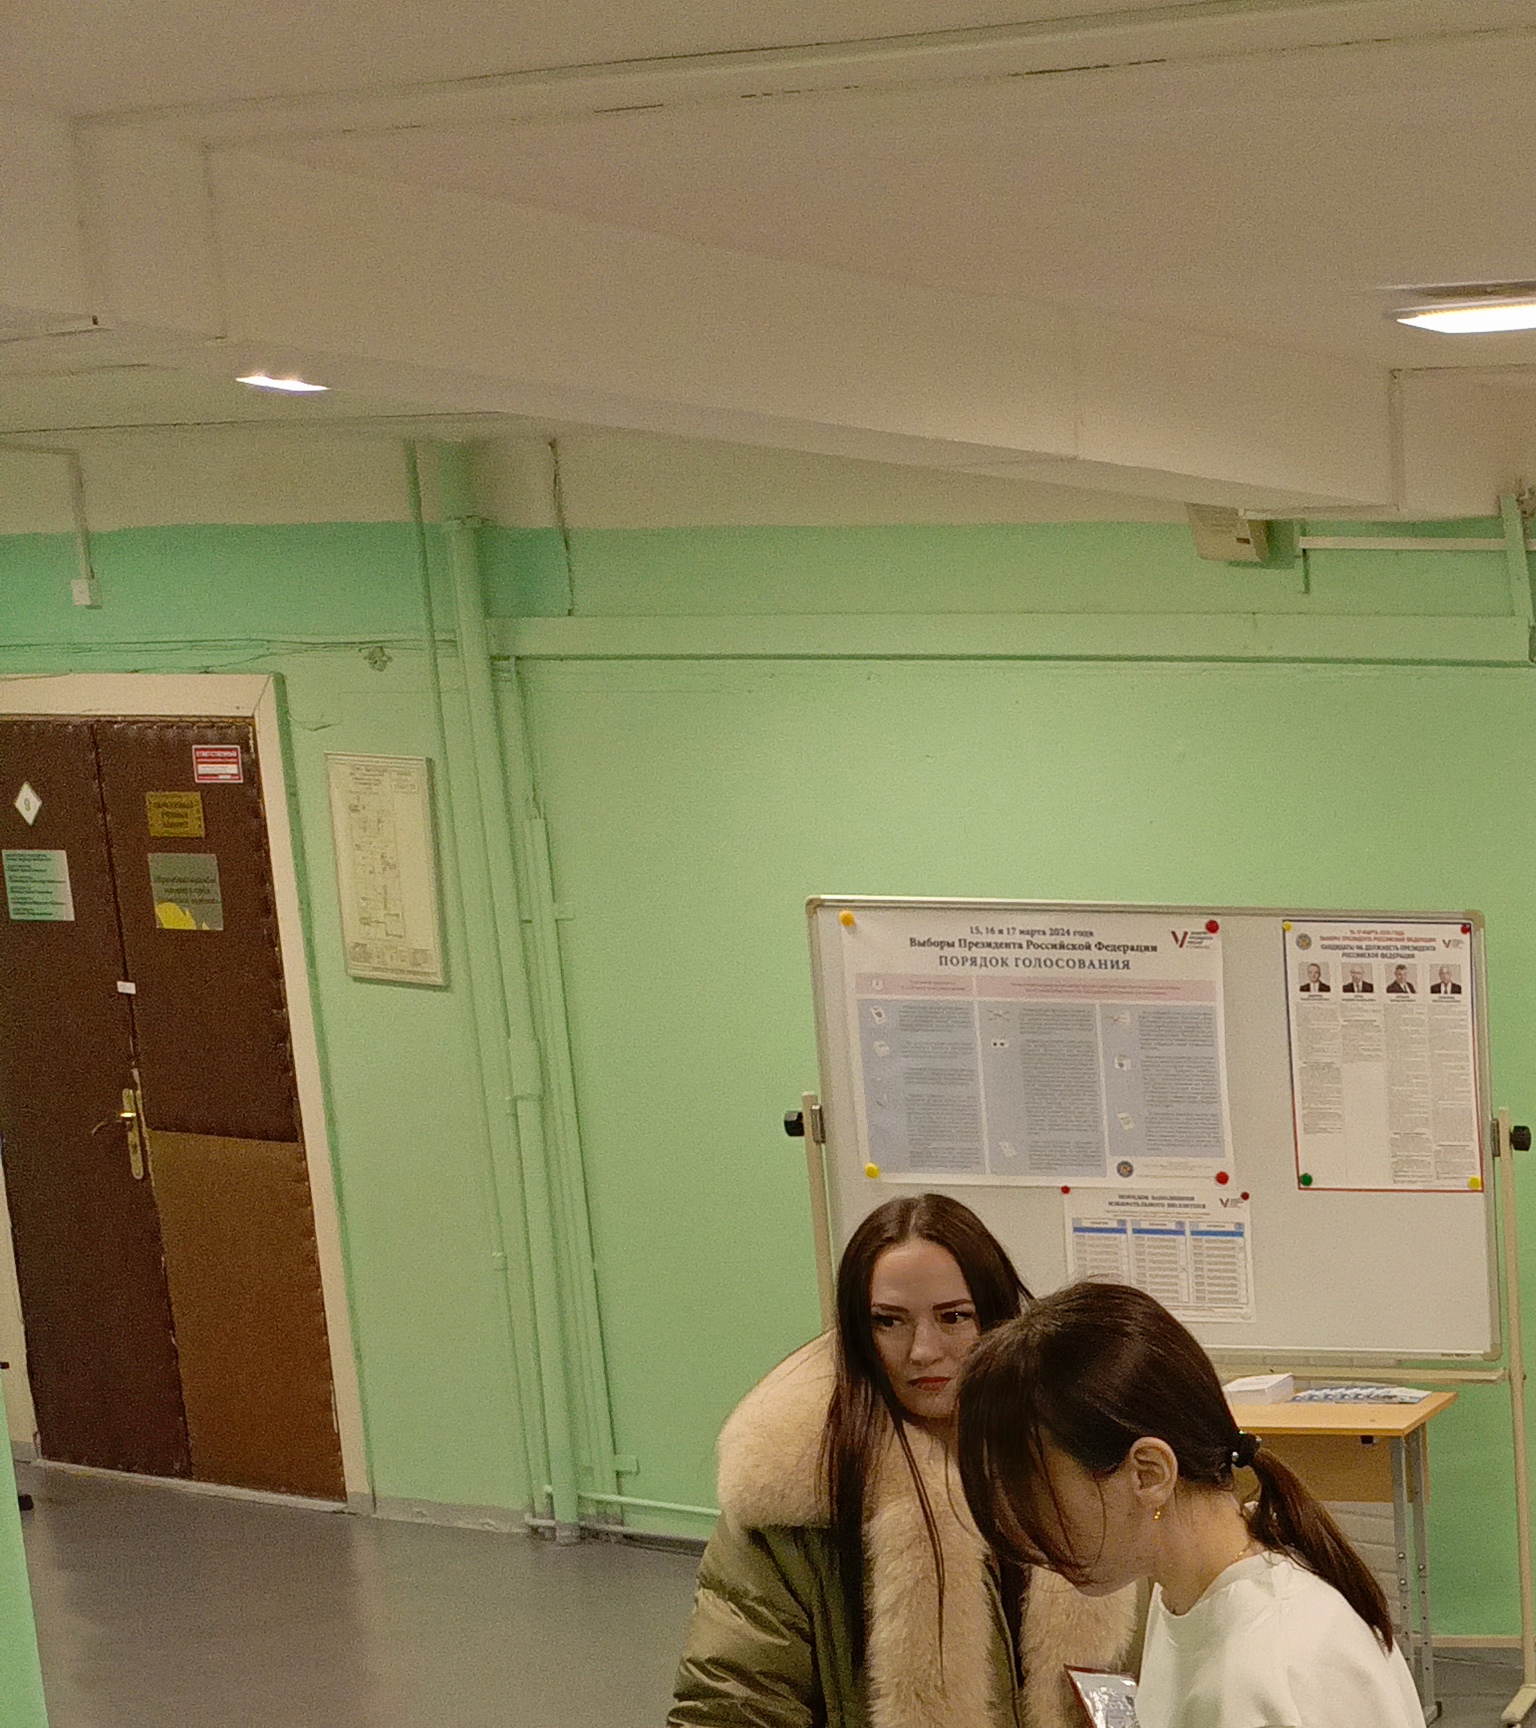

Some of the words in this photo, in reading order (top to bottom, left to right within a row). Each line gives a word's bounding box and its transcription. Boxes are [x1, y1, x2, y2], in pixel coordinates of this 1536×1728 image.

[985, 927, 996, 936] 16
[1006, 927, 1016, 936] 17
[1018, 929, 1046, 938] марта
[1049, 928, 1071, 937] 2024
[1073, 930, 1094, 938] года
[909, 937, 955, 951] Выборы
[958, 938, 1024, 951] Президента
[1026, 939, 1092, 951] Российской
[1094, 940, 1158, 953] Федерации
[938, 956, 1010, 969] ПОРЯДОК
[1014, 958, 1132, 970] ГОЛОСОВАНИЯ
